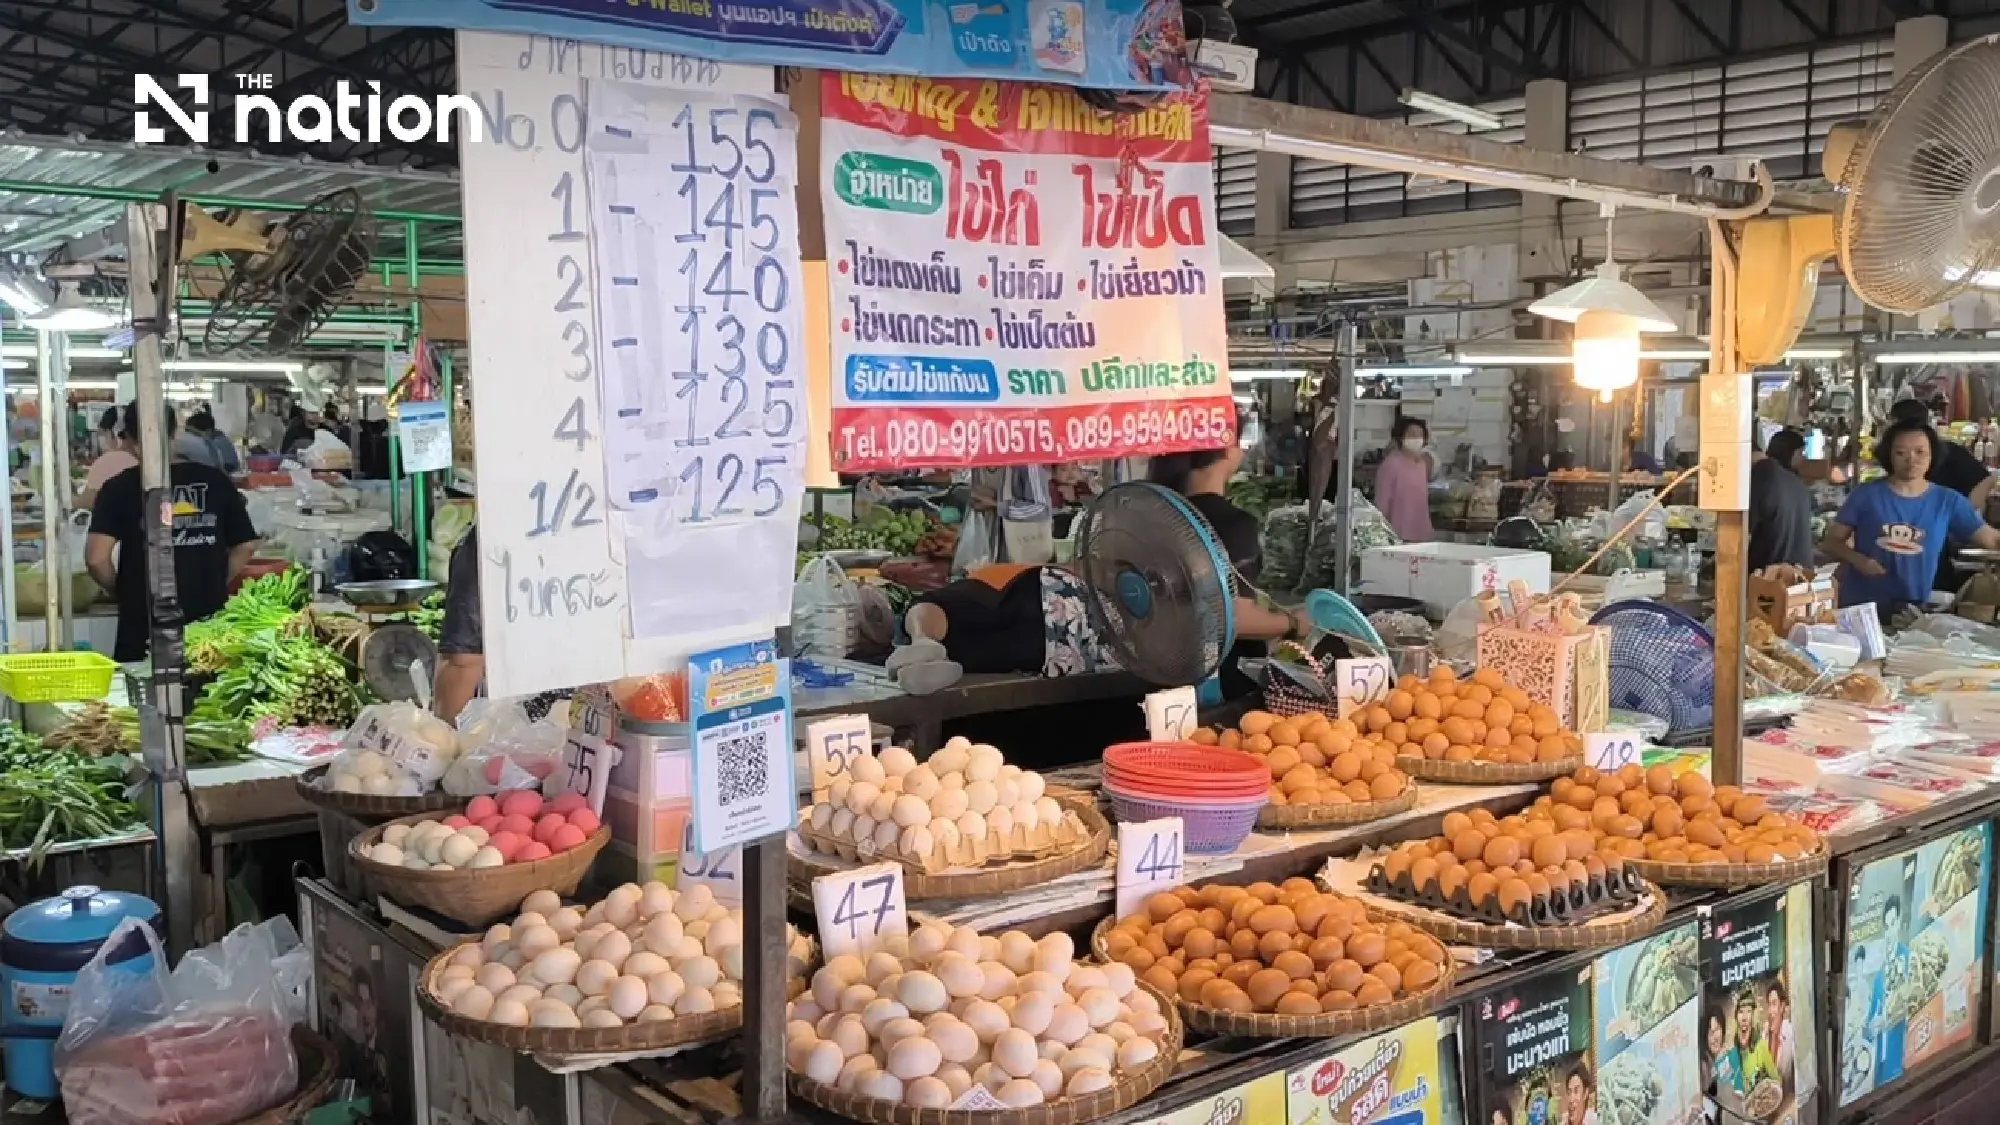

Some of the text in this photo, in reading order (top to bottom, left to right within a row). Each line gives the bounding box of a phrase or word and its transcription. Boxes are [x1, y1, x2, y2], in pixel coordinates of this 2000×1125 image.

[672, 103, 782, 183] 155
[549, 171, 585, 241] 1
[674, 174, 779, 251] 145
[850, 161, 933, 205] จำหน่าย
[940, 148, 1205, 249] ไข่ไก่ ไข่เป็ด
[554, 255, 587, 312] 2
[674, 248, 789, 313] 140
[845, 240, 1206, 300] ไข่แดงเค็ม ไข่เค็ม ไข่เยี่ยวม้า
[562, 320, 593, 382] 3
[672, 311, 788, 380] 130
[848, 295, 1096, 349] ไข่นกกระทา ไข่เป็ดต้ม
[854, 353, 1217, 395] รับต้มไข่แก้บน ราคา ปลีกและส่ง
[554, 396, 597, 451] 4
[675, 375, 794, 448] 125
[1066, 408, 1227, 450] 089-9594035
[173, 483, 209, 513] AT
[526, 468, 603, 538] 1/2
[678, 453, 788, 523] 125
[1351, 663, 1386, 705] 52
[567, 739, 595, 797] 75
[824, 729, 866, 777] 55
[1135, 832, 1182, 880] 44
[833, 874, 896, 938] 47
[1507, 1026, 1569, 1074] มะนาวแท้
